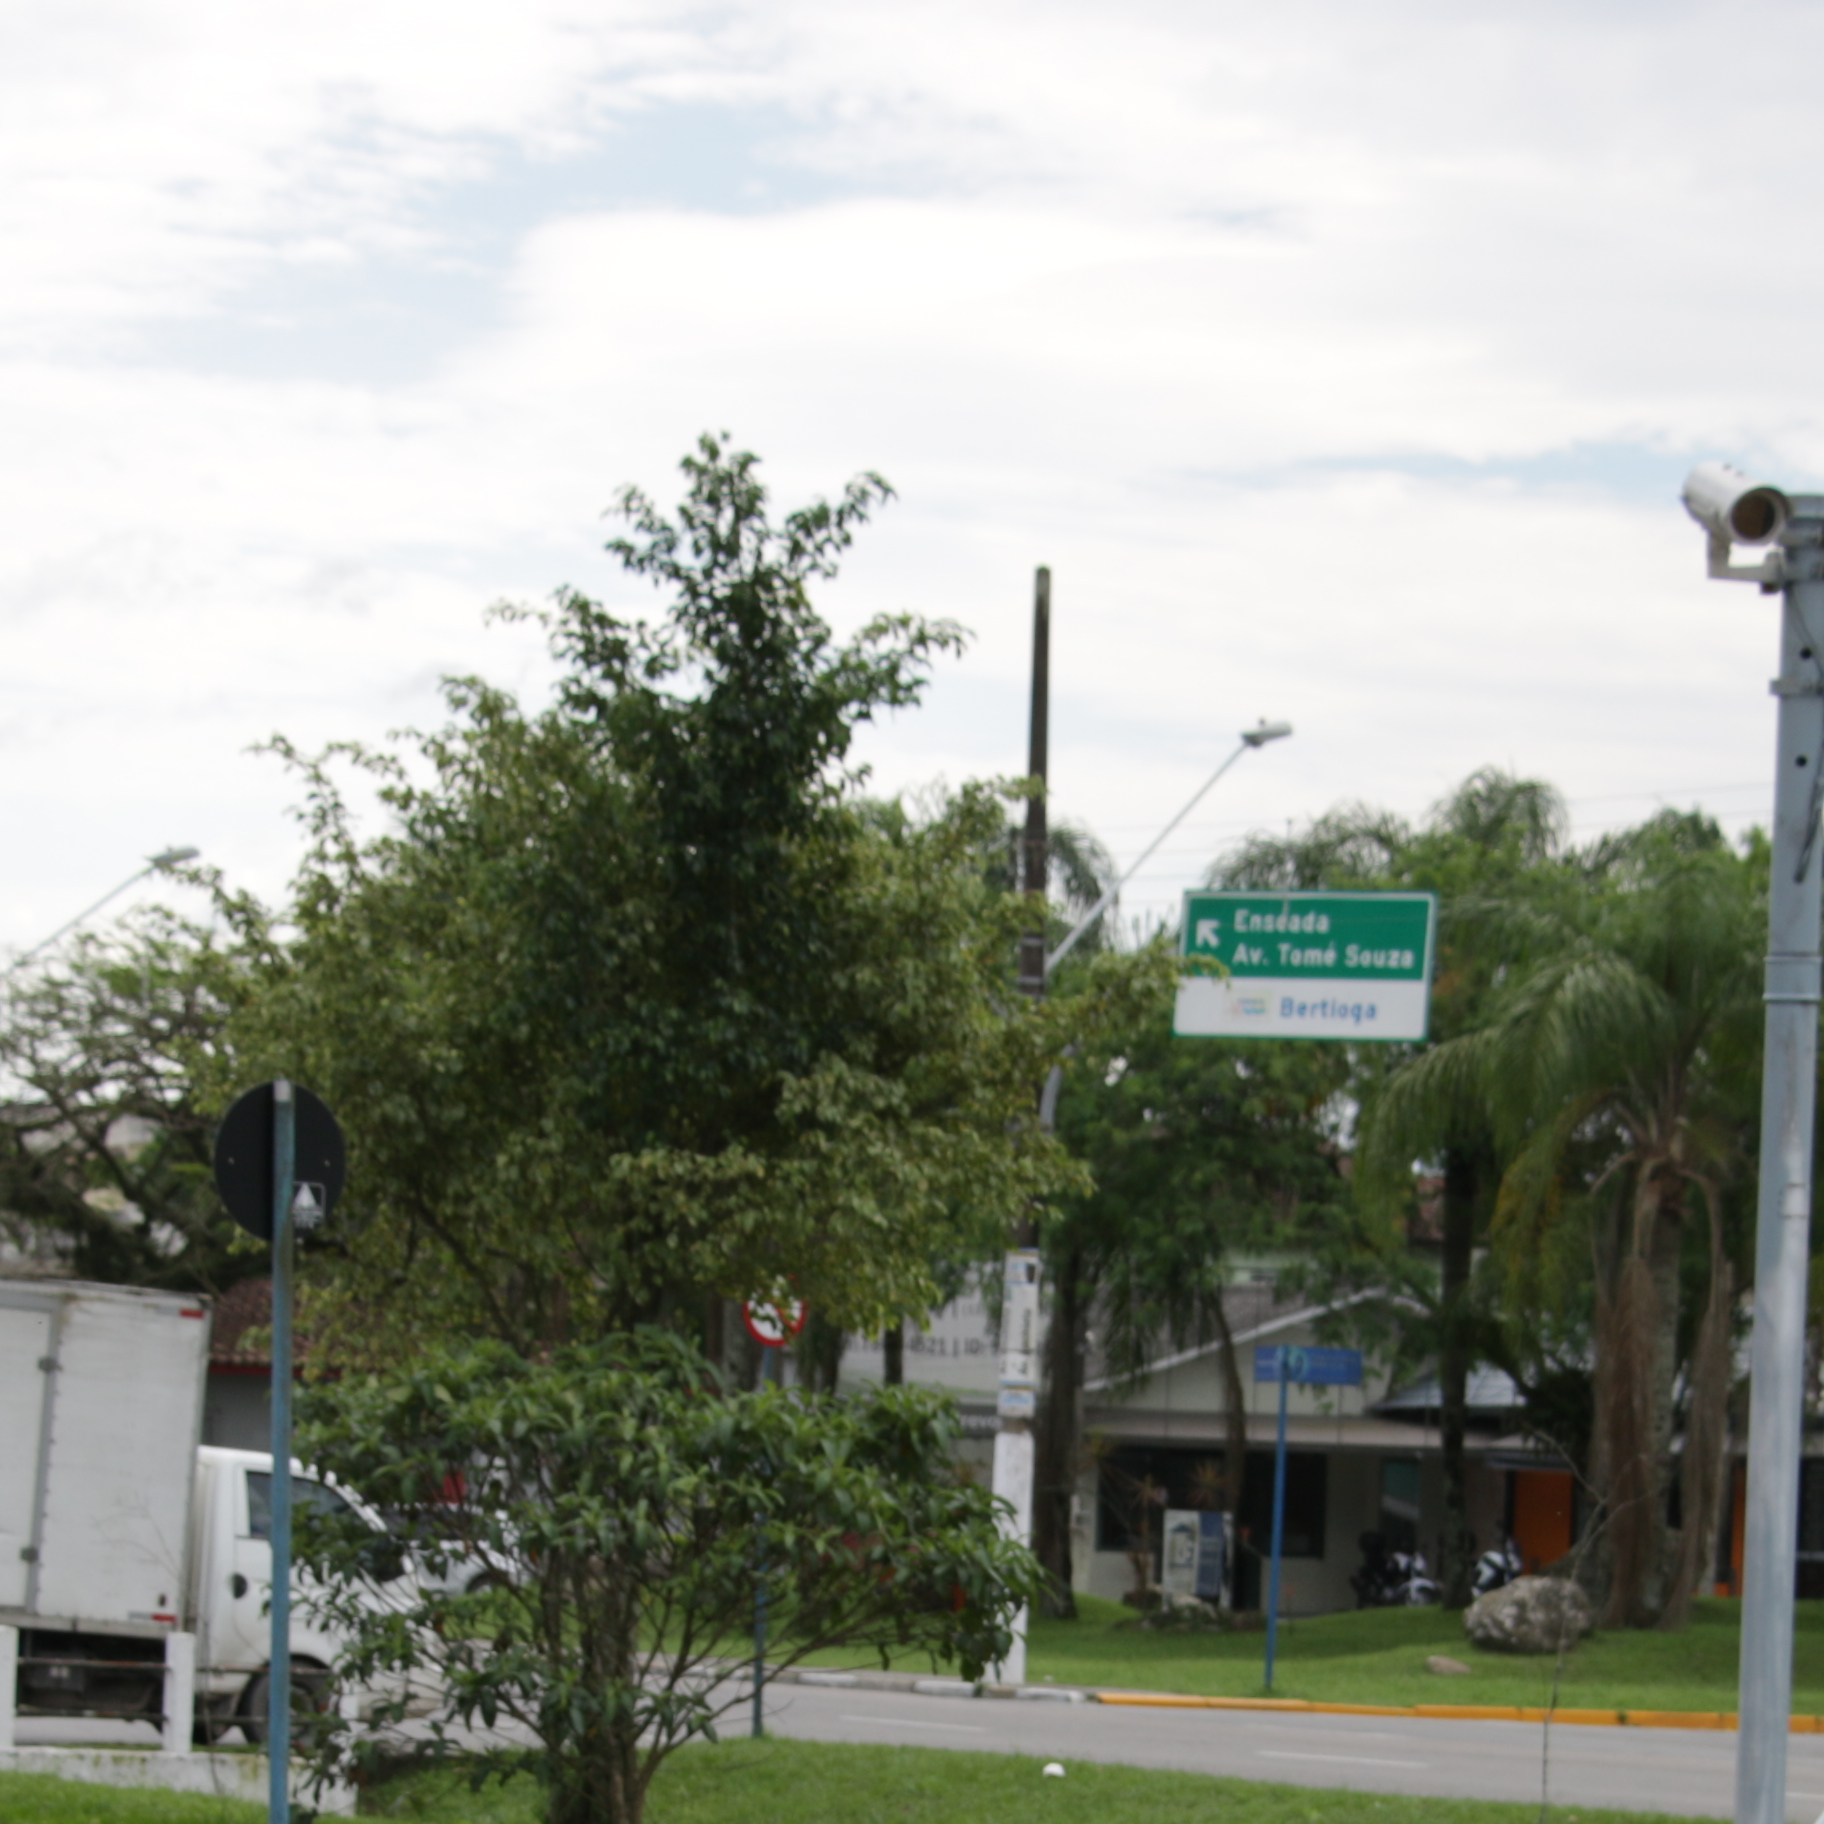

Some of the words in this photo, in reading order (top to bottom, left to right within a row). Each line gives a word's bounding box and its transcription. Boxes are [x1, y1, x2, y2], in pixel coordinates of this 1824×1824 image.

[1234, 909, 1330, 935] Enseada
[1232, 943, 1270, 967] Av.
[1277, 941, 1337, 968] Tomé
[1345, 944, 1415, 969] Souza
[1280, 997, 1377, 1024] Bertioga
